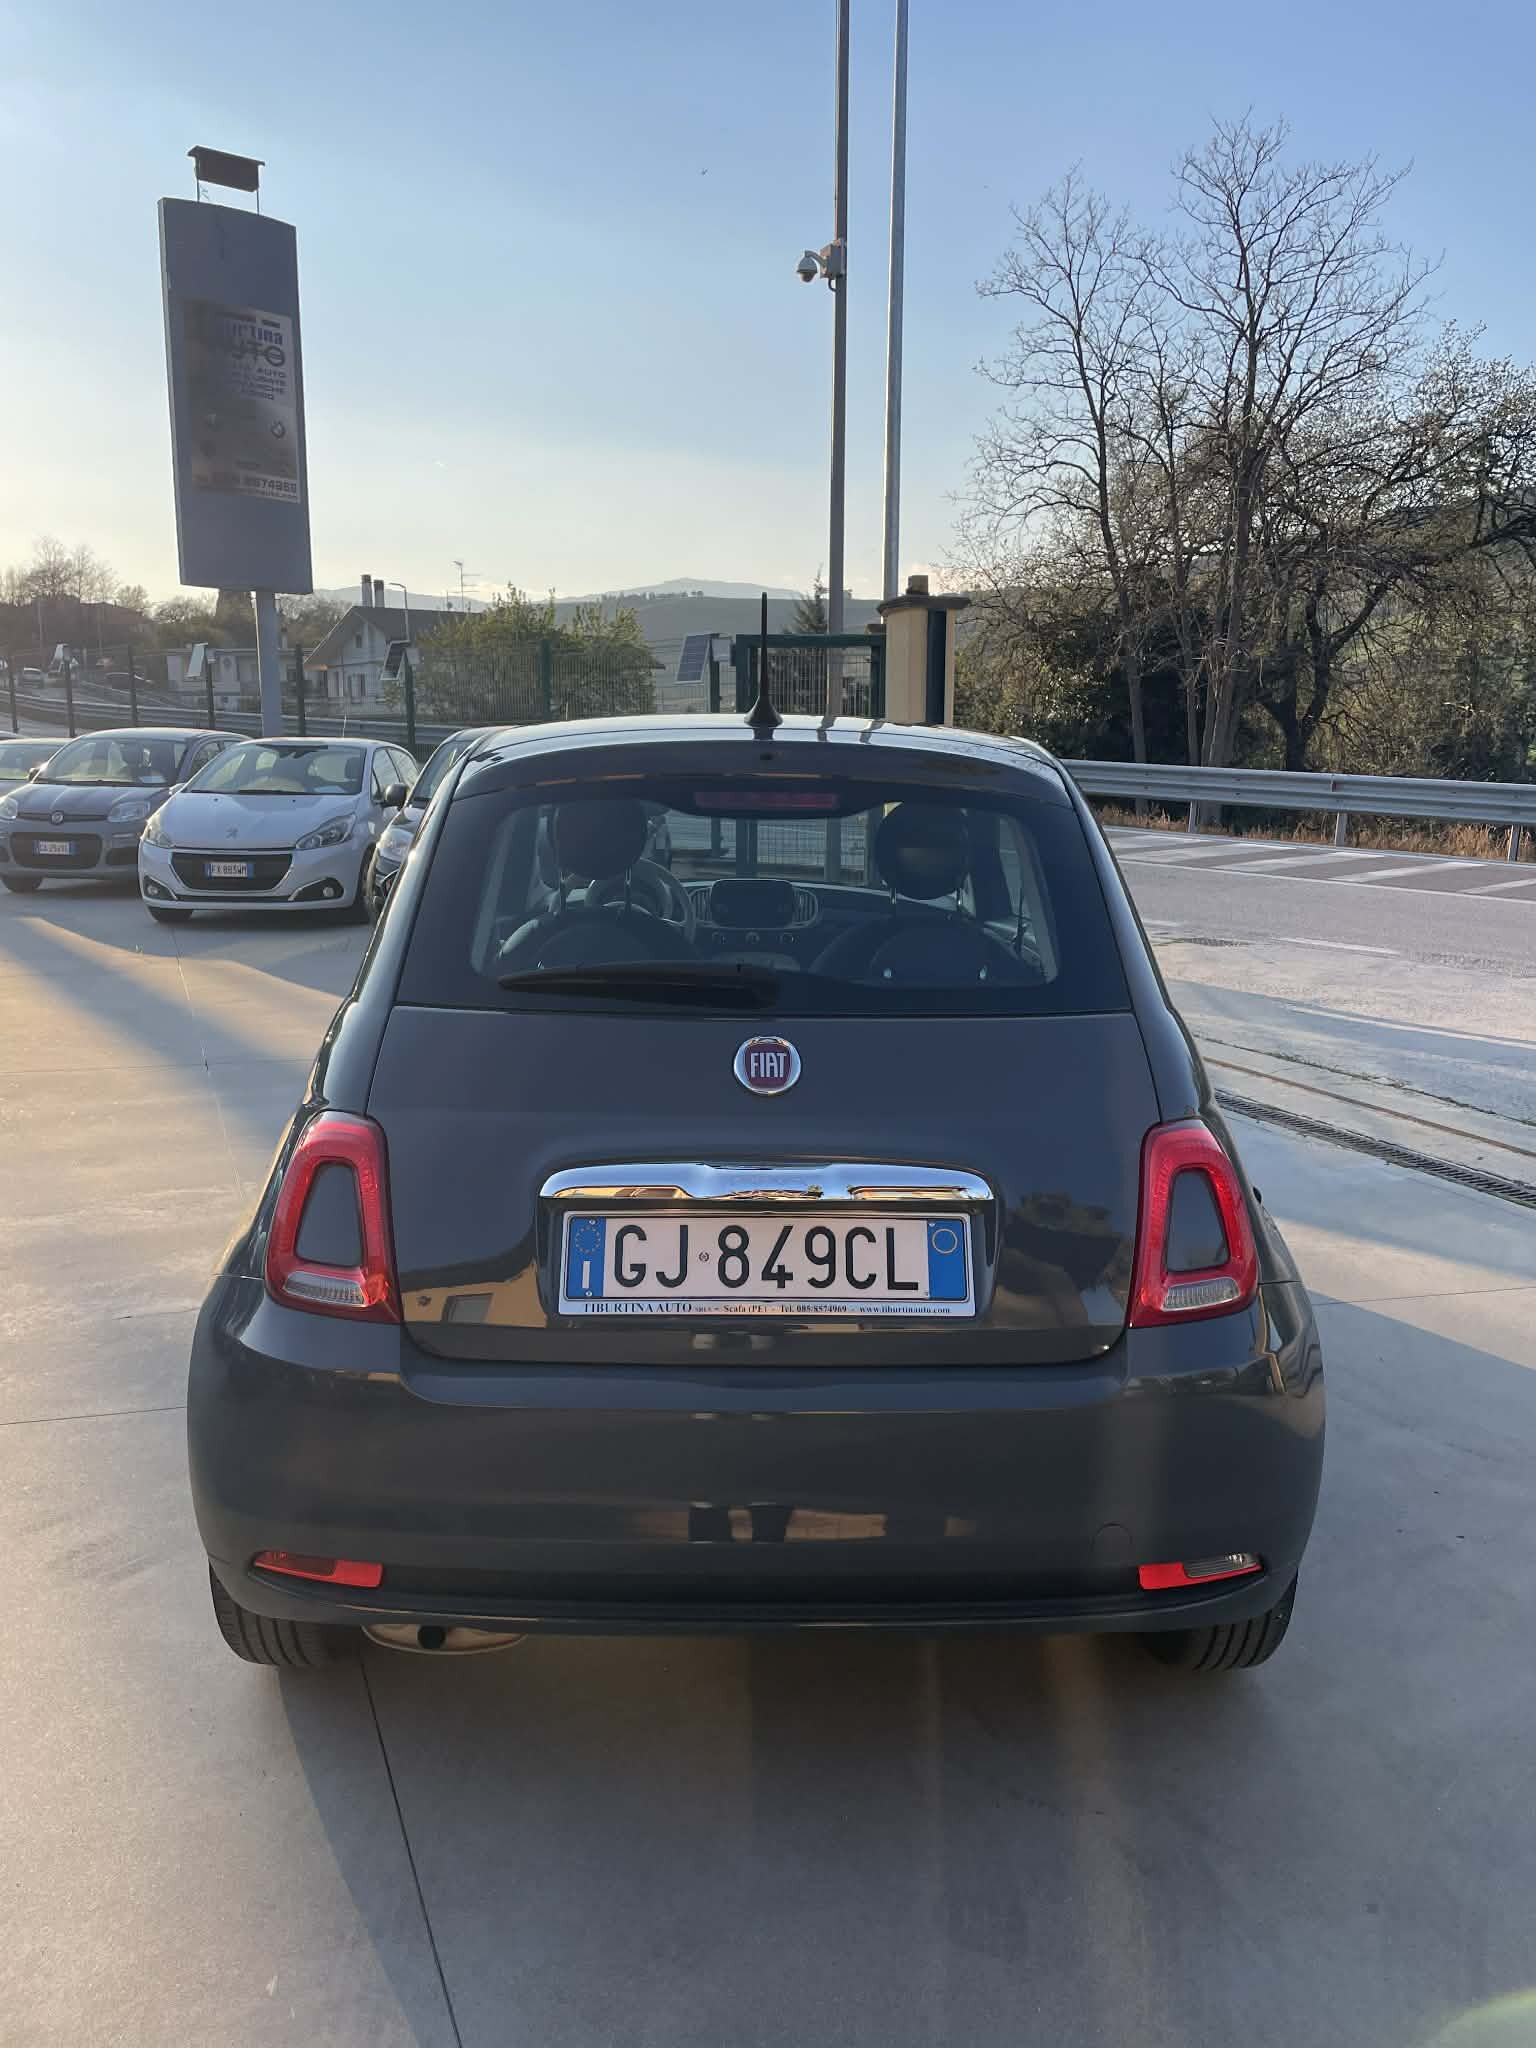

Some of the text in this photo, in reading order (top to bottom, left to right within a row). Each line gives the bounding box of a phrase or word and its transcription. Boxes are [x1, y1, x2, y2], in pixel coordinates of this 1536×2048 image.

[750, 1052, 788, 1078] FIAT
[584, 1302, 653, 1313] TIBURTINA
[655, 1303, 692, 1313] AUTO
